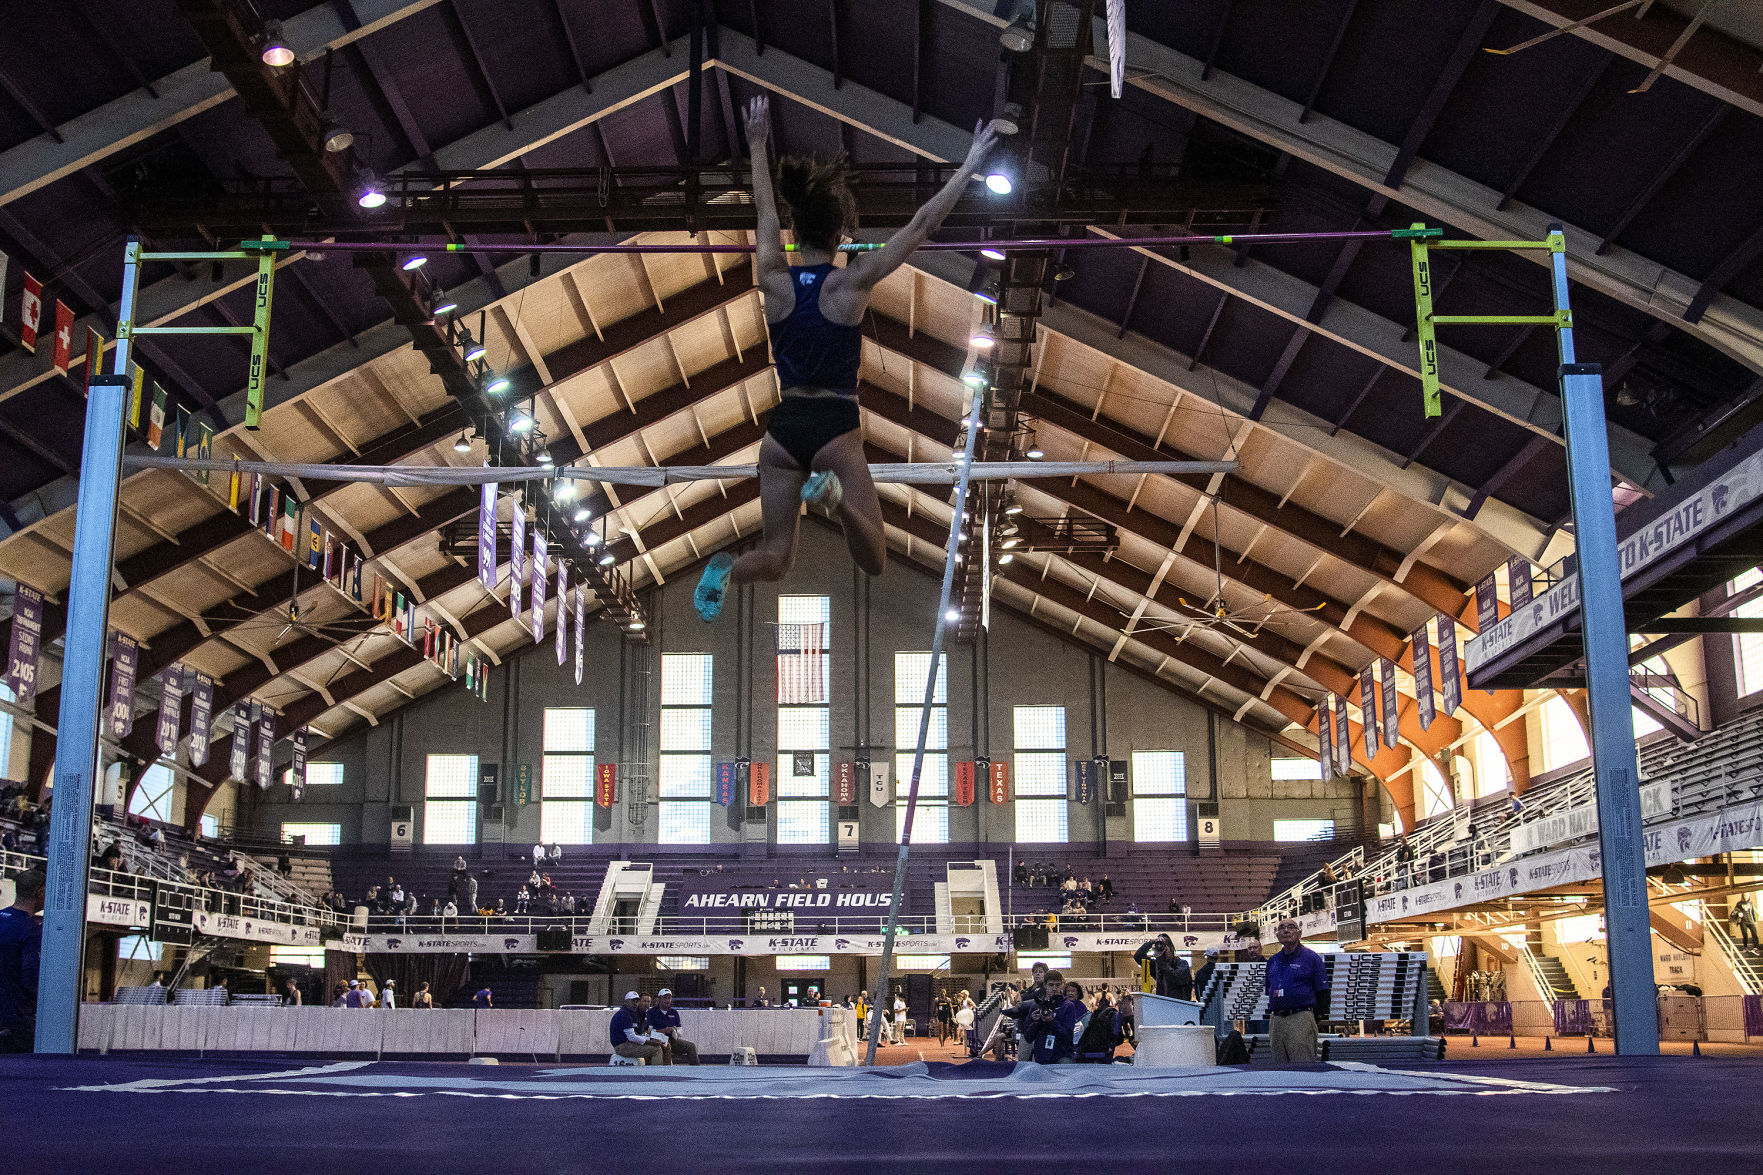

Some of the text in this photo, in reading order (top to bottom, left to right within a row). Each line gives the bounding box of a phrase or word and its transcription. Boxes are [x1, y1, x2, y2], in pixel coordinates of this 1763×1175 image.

[1418, 261, 1430, 296] UCS
[257, 273, 268, 308] UCS
[1425, 339, 1437, 376] UCS
[250, 354, 261, 390] UCS
[1640, 497, 1703, 562] K-STATE
[1481, 619, 1513, 651] K-STATE
[519, 764, 527, 805] BAYLOR
[721, 762, 729, 805] KANSAS
[840, 763, 848, 802] OKLAHOMA
[116, 786, 123, 799] 5
[396, 824, 406, 837] 6
[844, 825, 854, 837] 7
[1204, 821, 1214, 834] 8
[1474, 871, 1501, 890] K-STATE
[684, 893, 770, 908] AHEARN
[775, 893, 832, 908] FIELD
[1377, 898, 1396, 913] K-STATE
[100, 901, 131, 916] K-STATE
[217, 917, 239, 930] K-STATE
[1685, 920, 1692, 930] 11
[769, 938, 818, 947] K-STATE
[1501, 942, 1509, 951] 10
